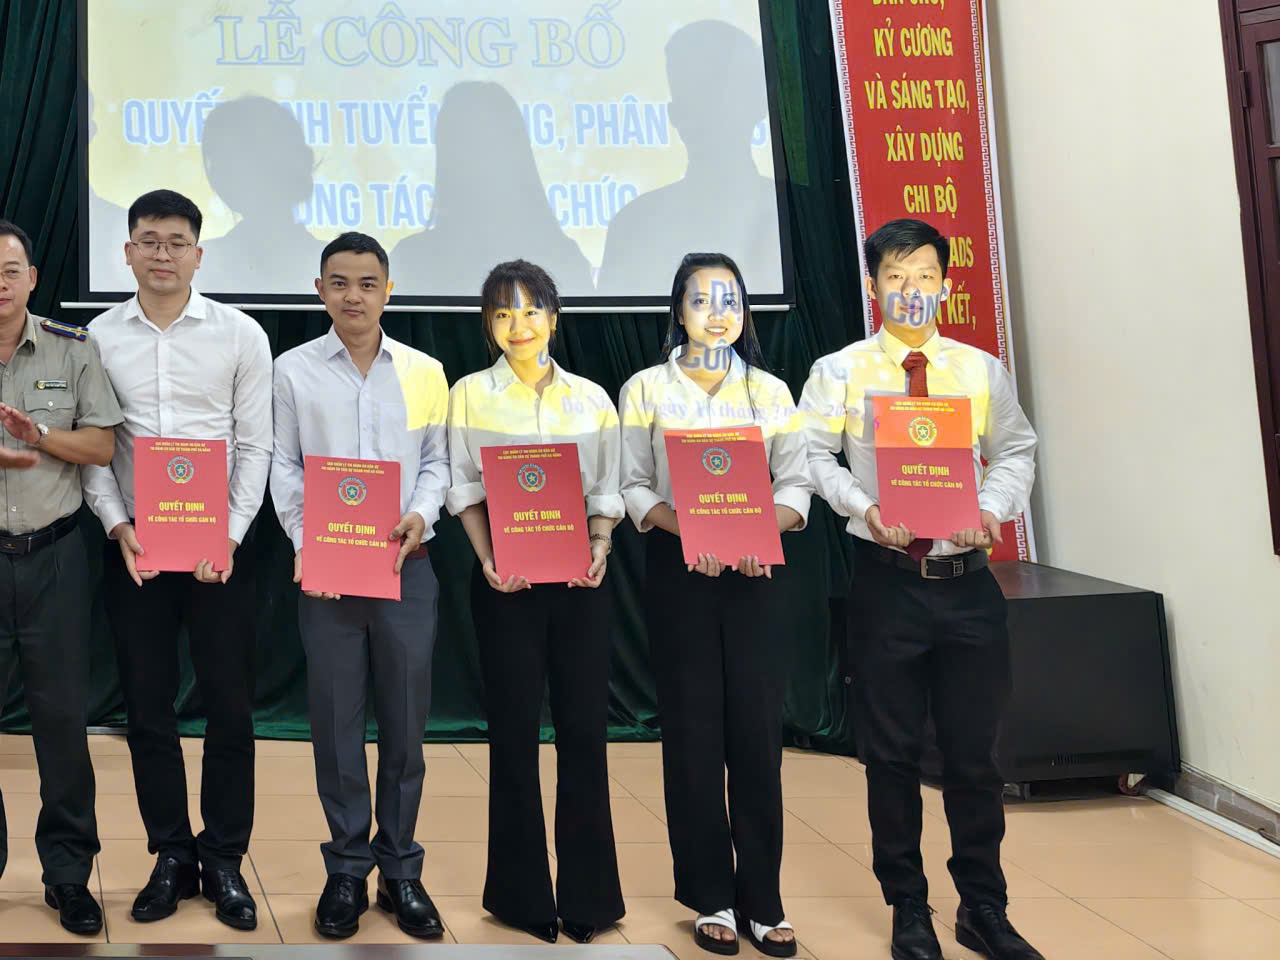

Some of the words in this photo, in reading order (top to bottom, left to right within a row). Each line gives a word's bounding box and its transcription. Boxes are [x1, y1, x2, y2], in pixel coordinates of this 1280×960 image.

[321, 1, 518, 68] CÔNG
[874, 18, 894, 56] KỶ
[900, 26, 953, 56] CƯƠNG
[864, 73, 888, 109] VÀ
[891, 73, 933, 109] SÁNG
[935, 80, 969, 115] TẠO,
[124, 88, 224, 144] QUYẾ
[885, 125, 915, 161] XÂY
[920, 128, 963, 168] DỰNG
[904, 185, 930, 213] CHI
[934, 177, 958, 218] BỘ
[949, 236, 974, 268] ADS
[902, 464, 927, 475] QUYẾT
[159, 500, 183, 512] QUYẾT
[514, 509, 538, 521] QUYẾT
[699, 492, 724, 503] QUYẾT
[328, 522, 353, 533] QUYẾT
